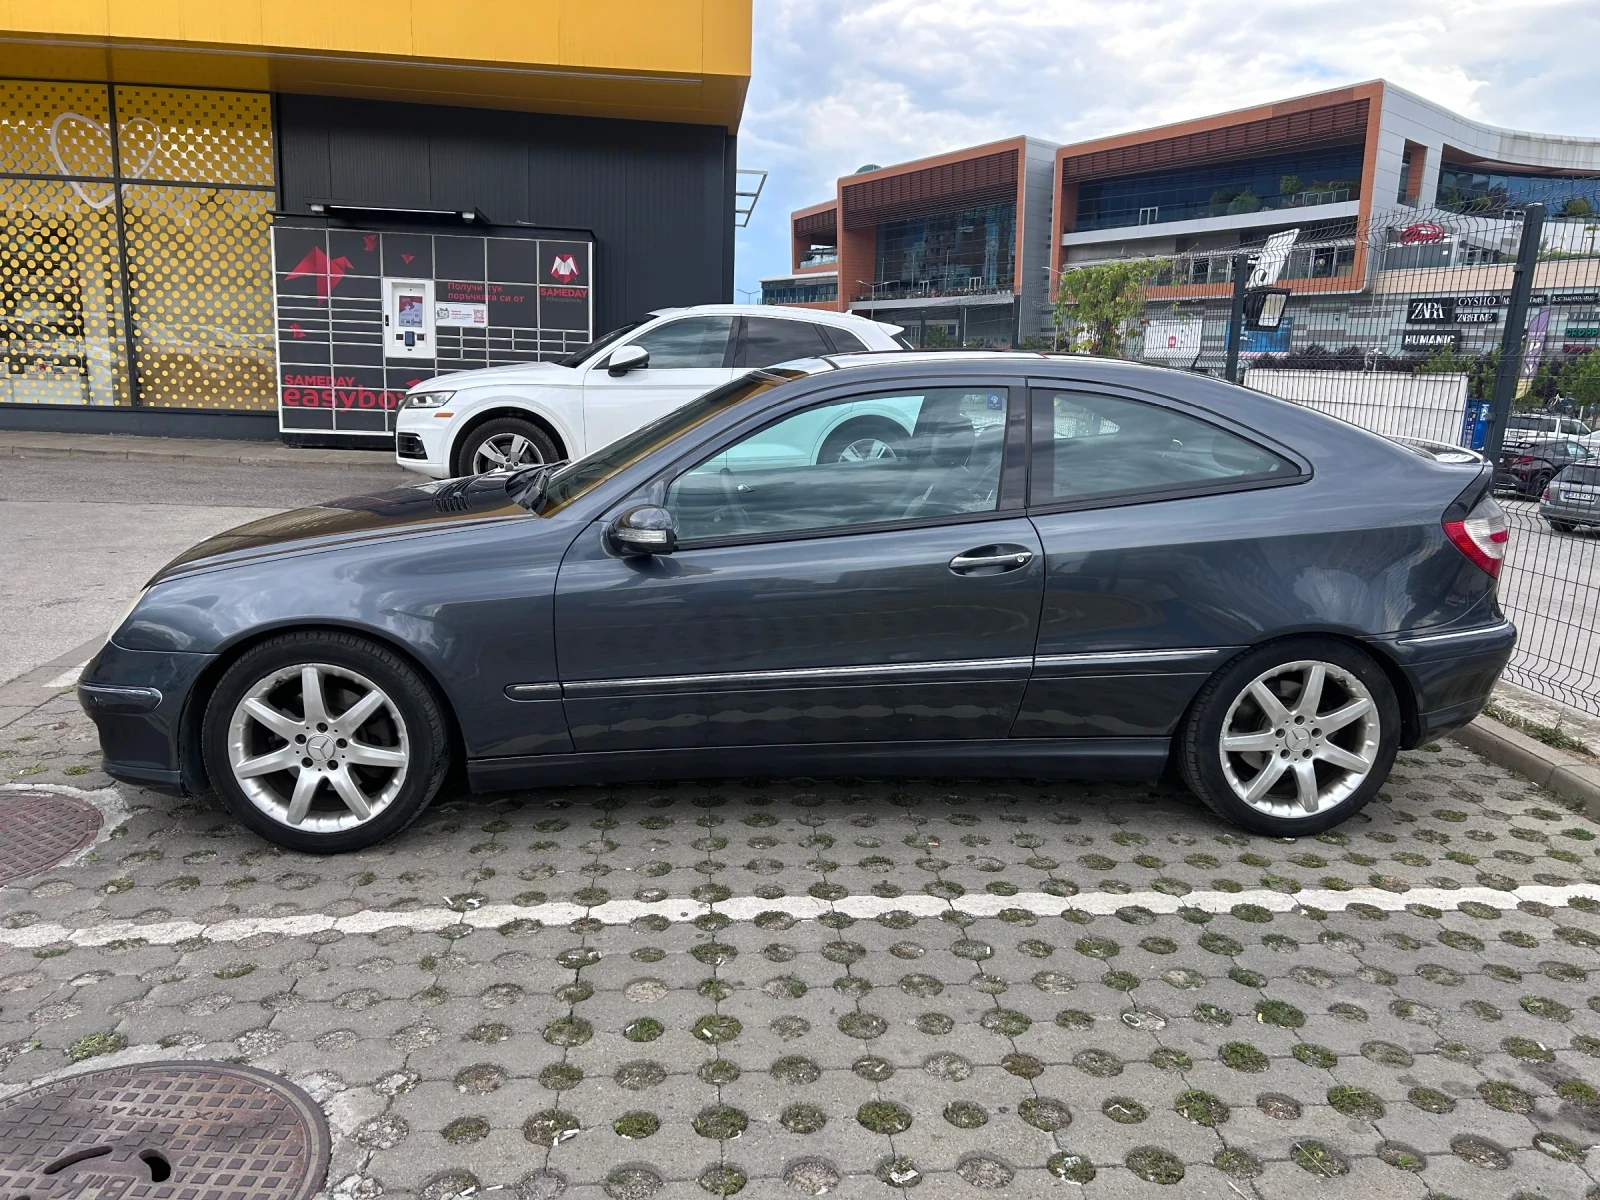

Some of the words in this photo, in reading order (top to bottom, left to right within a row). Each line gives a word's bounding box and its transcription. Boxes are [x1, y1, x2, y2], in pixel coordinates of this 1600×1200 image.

[447, 281, 483, 292] Получи
[488, 285, 503, 293] тук
[541, 288, 588, 298] SAMEDAY
[1458, 296, 1496, 306] OYSHO
[1411, 302, 1445, 319] ZARA
[1404, 334, 1455, 346] HUMANIC
[284, 374, 355, 387] SAMEDAY
[86, 1104, 234, 1121] ИХТИМАН
